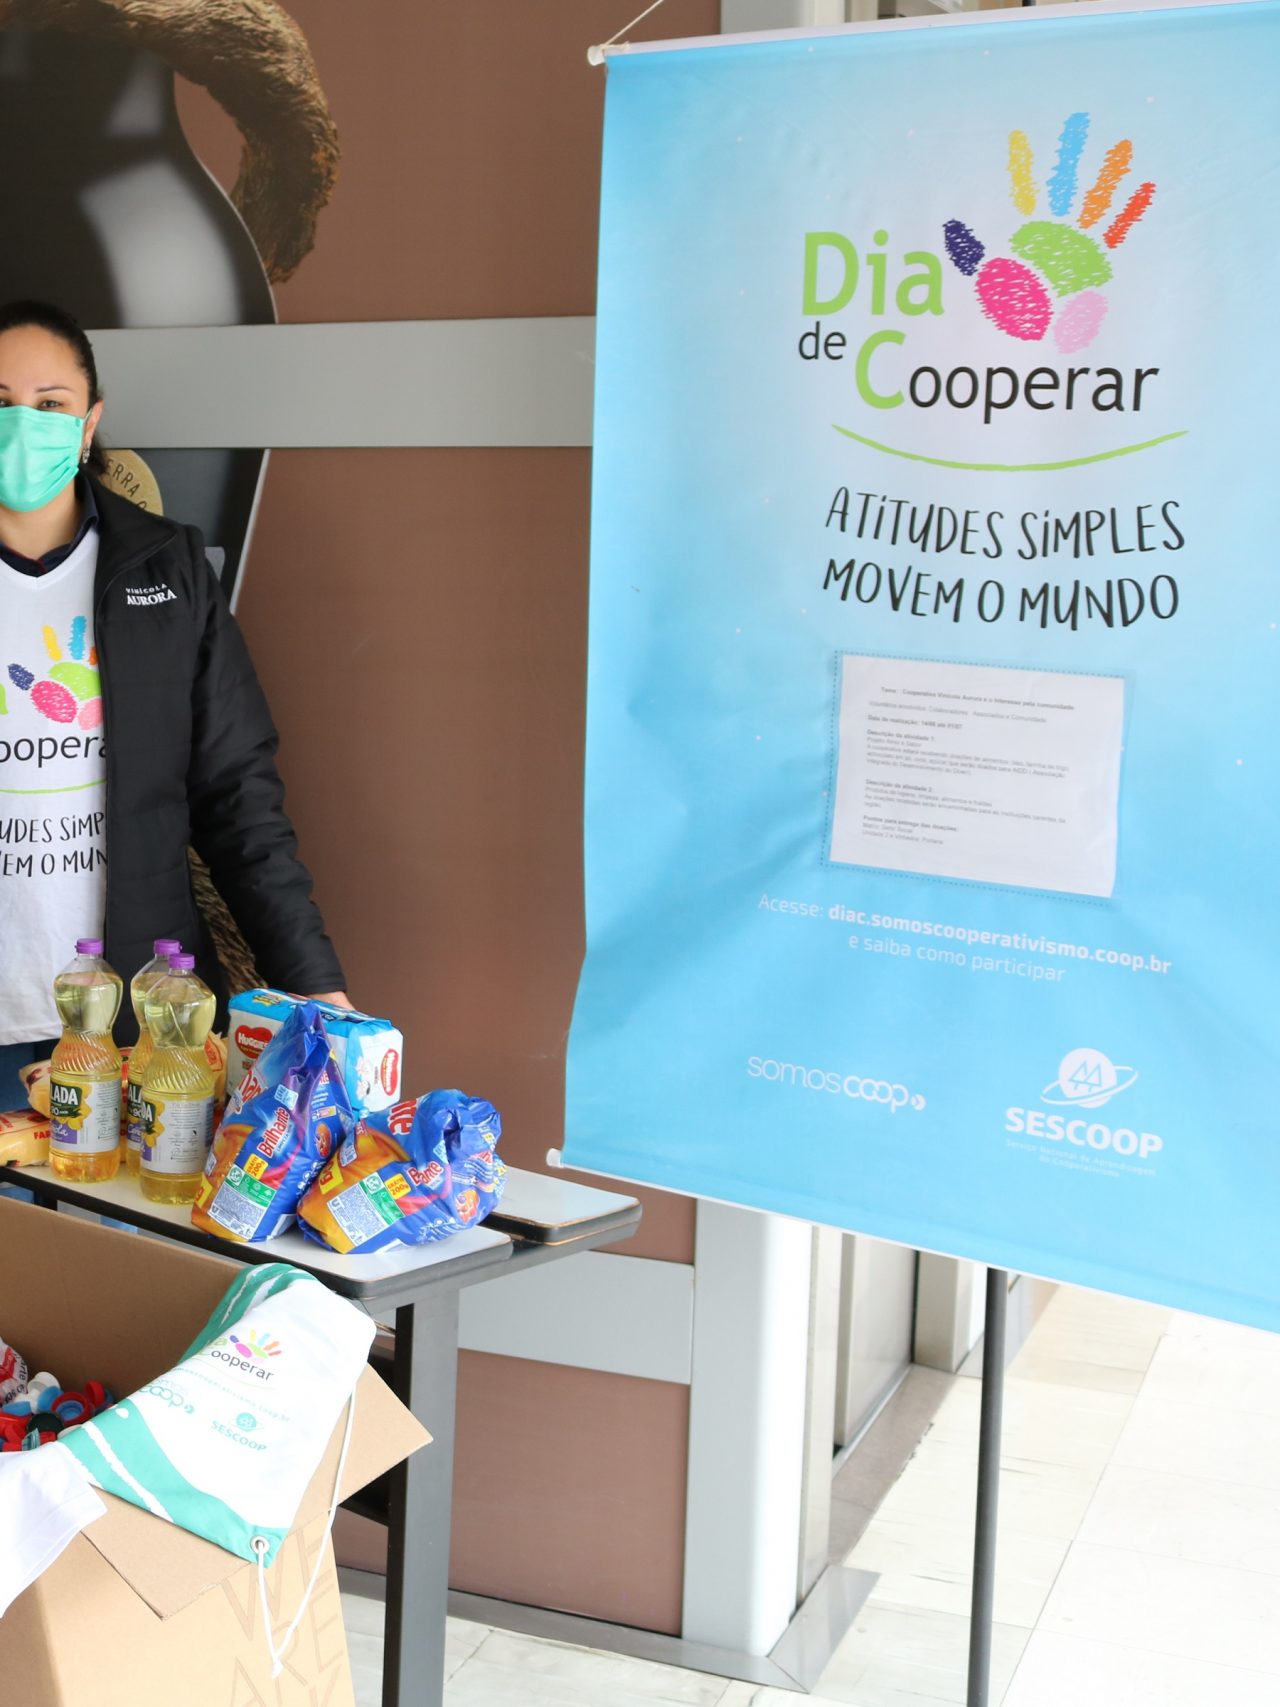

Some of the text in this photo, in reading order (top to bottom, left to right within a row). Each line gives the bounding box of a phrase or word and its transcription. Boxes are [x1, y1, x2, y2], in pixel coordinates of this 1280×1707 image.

[802, 229, 944, 316] Dia
[798, 321, 1160, 424] de Cooperar
[126, 588, 177, 606] AURORA
[823, 557, 1179, 631] MOVEM O MUNDO
[41, 853, 55, 875] O
[63, 847, 107, 874] MUN
[758, 893, 1172, 975] Acesse: diac.somoscooperativismo.coop.br
[848, 934, 1066, 983] e saiba como participar
[747, 1056, 910, 1114] somoscoop
[257, 1106, 290, 1158] Brilhante
[1005, 1106, 1164, 1159] SESCOOP
[210, 1420, 267, 1451] SESCOOP
